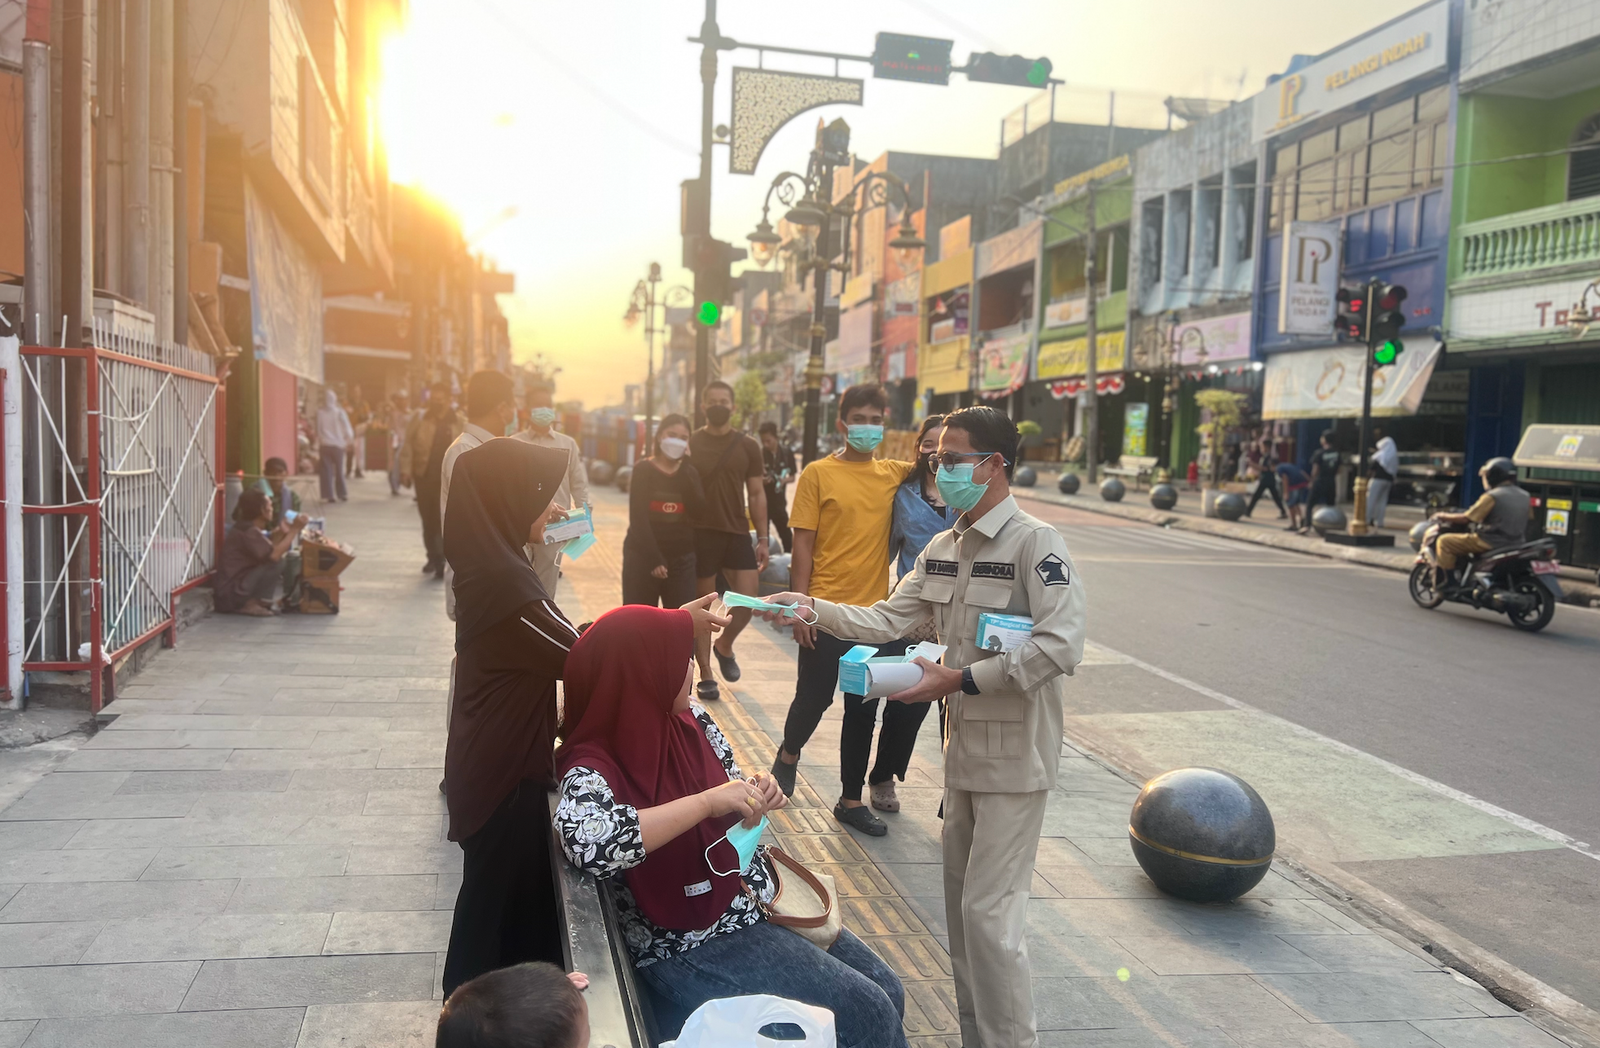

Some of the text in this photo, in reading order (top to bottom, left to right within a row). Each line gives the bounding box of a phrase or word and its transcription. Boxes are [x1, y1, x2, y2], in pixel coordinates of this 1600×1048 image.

[1325, 33, 1429, 90] PELANGI INDAH
[1291, 295, 1330, 307] PELANGI
[1293, 307, 1327, 317] INDAH
[1535, 301, 1600, 328] Too
[999, 620, 1021, 629] Surgical
